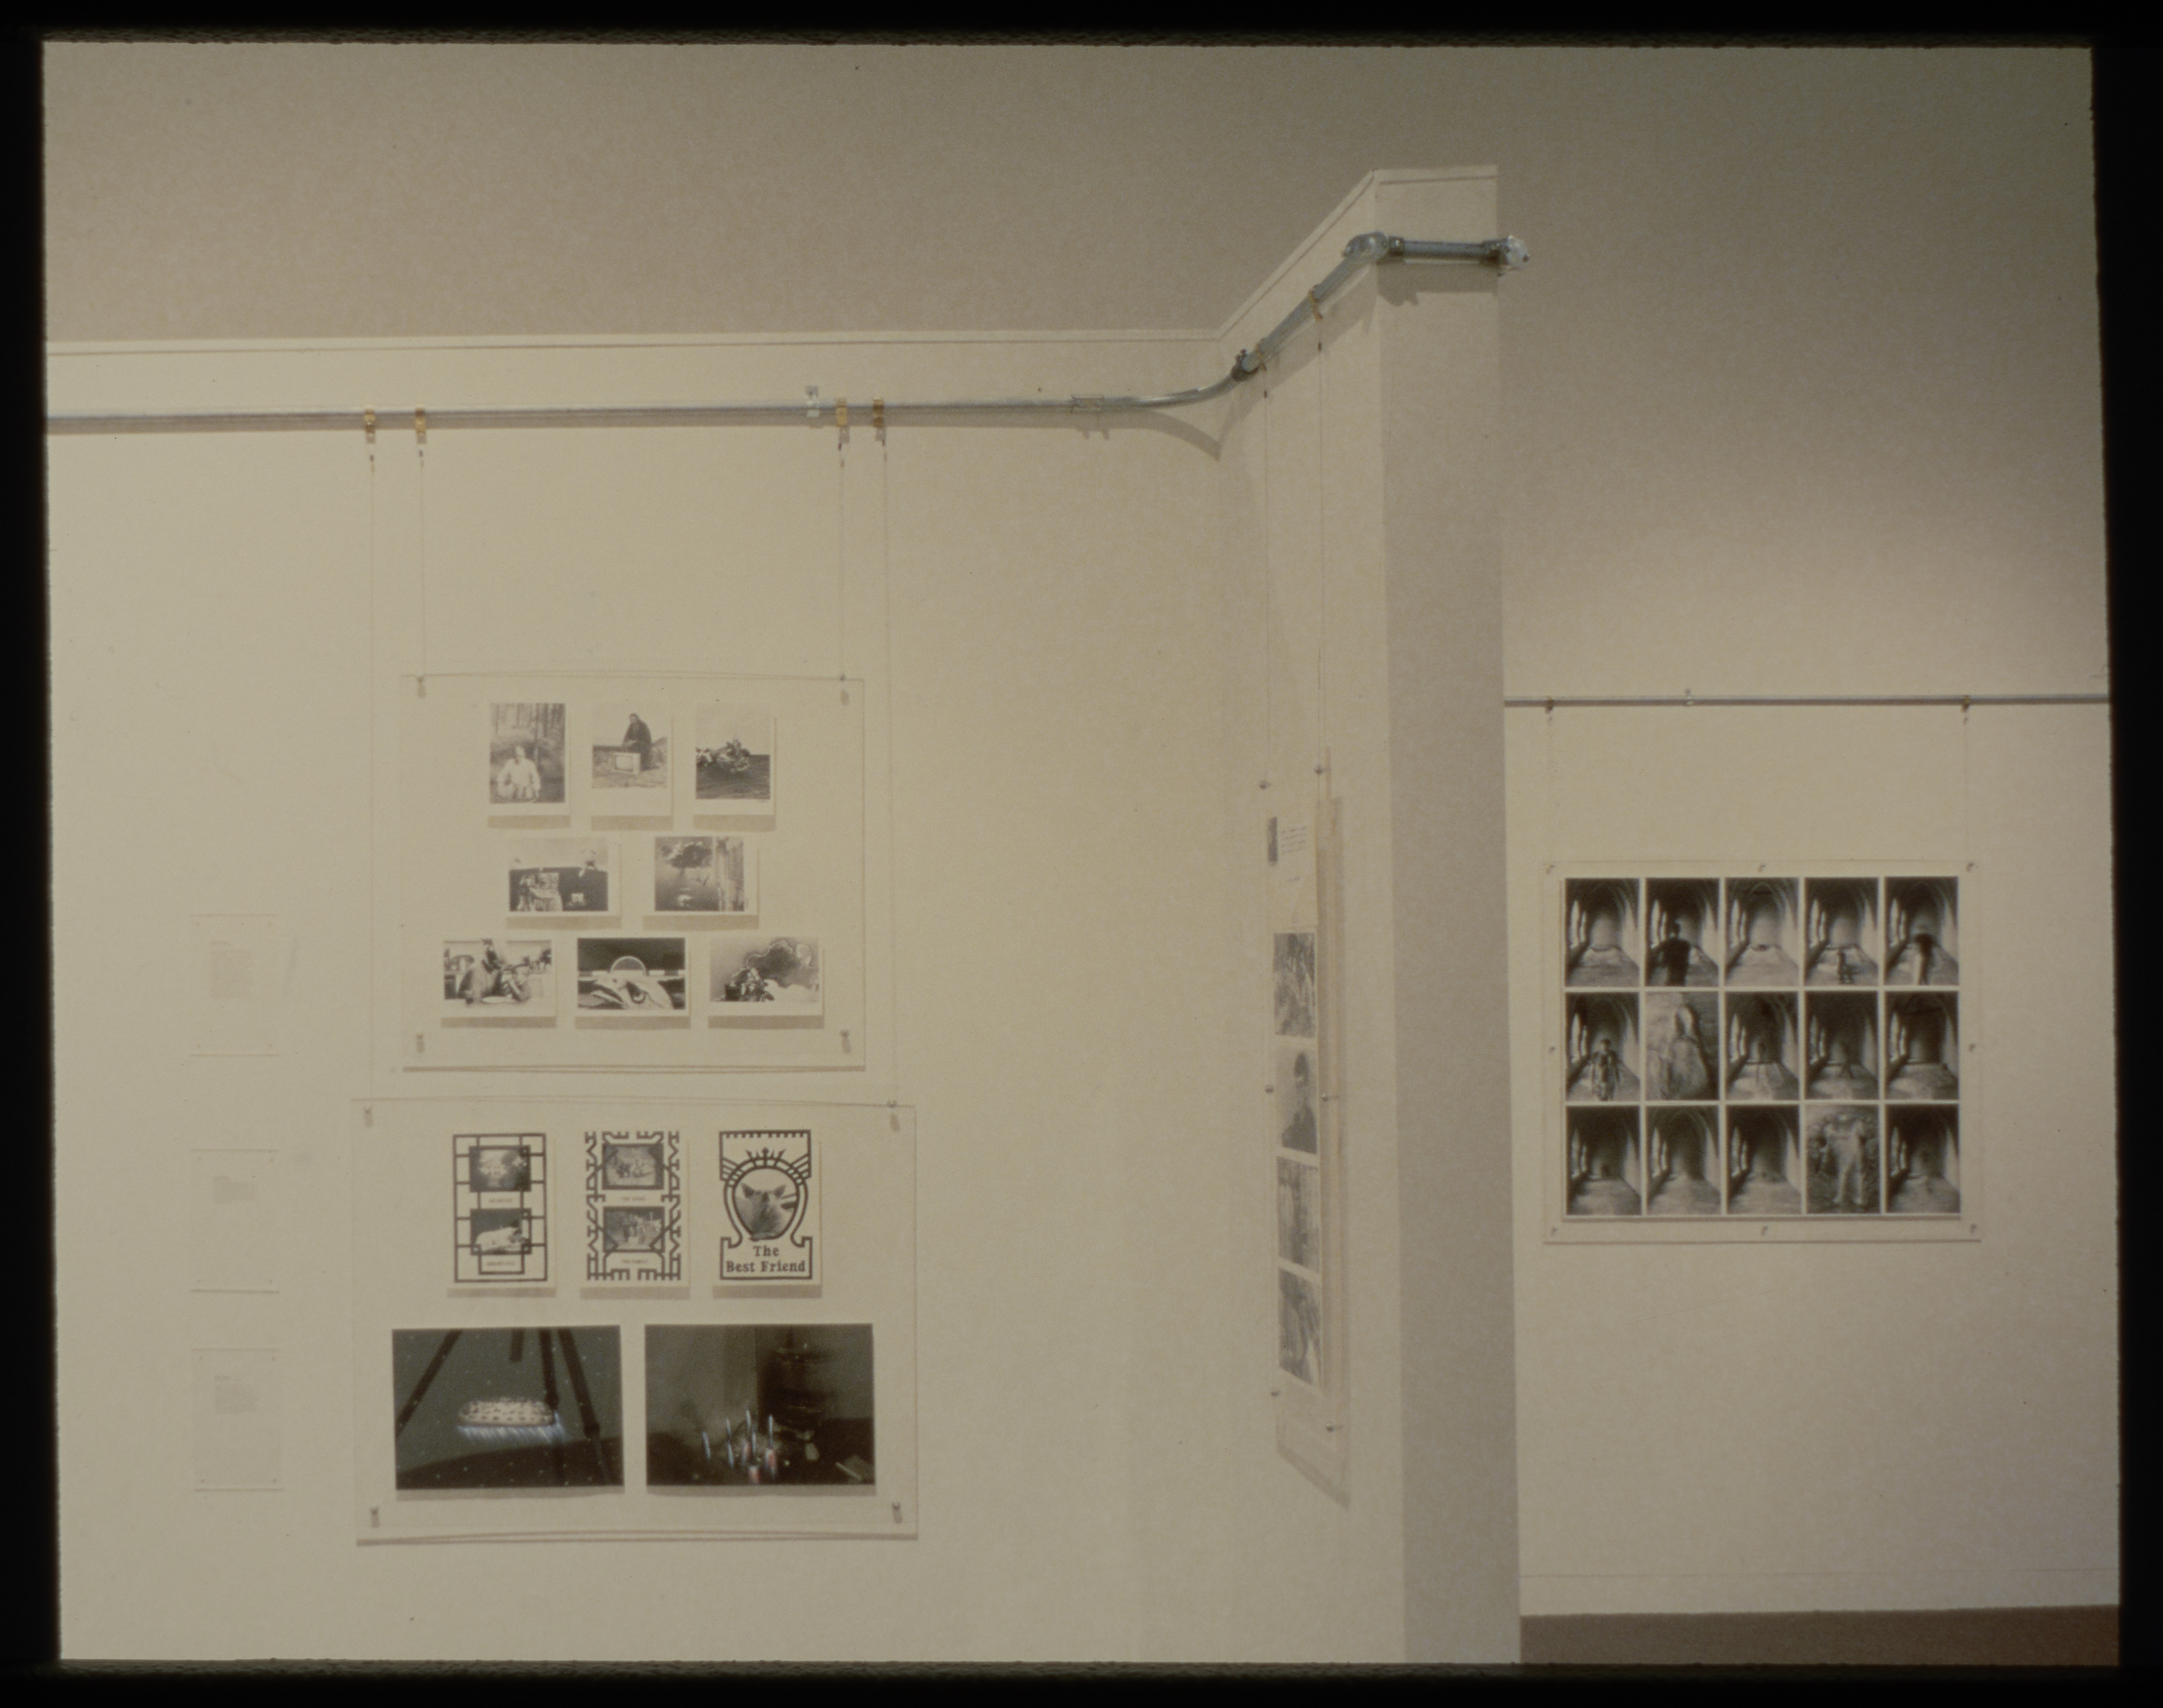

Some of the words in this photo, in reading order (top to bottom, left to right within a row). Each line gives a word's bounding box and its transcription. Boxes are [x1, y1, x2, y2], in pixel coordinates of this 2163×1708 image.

[753, 1245, 780, 1256] The
[726, 1261, 756, 1272] Best
[761, 1260, 805, 1272] Friend
